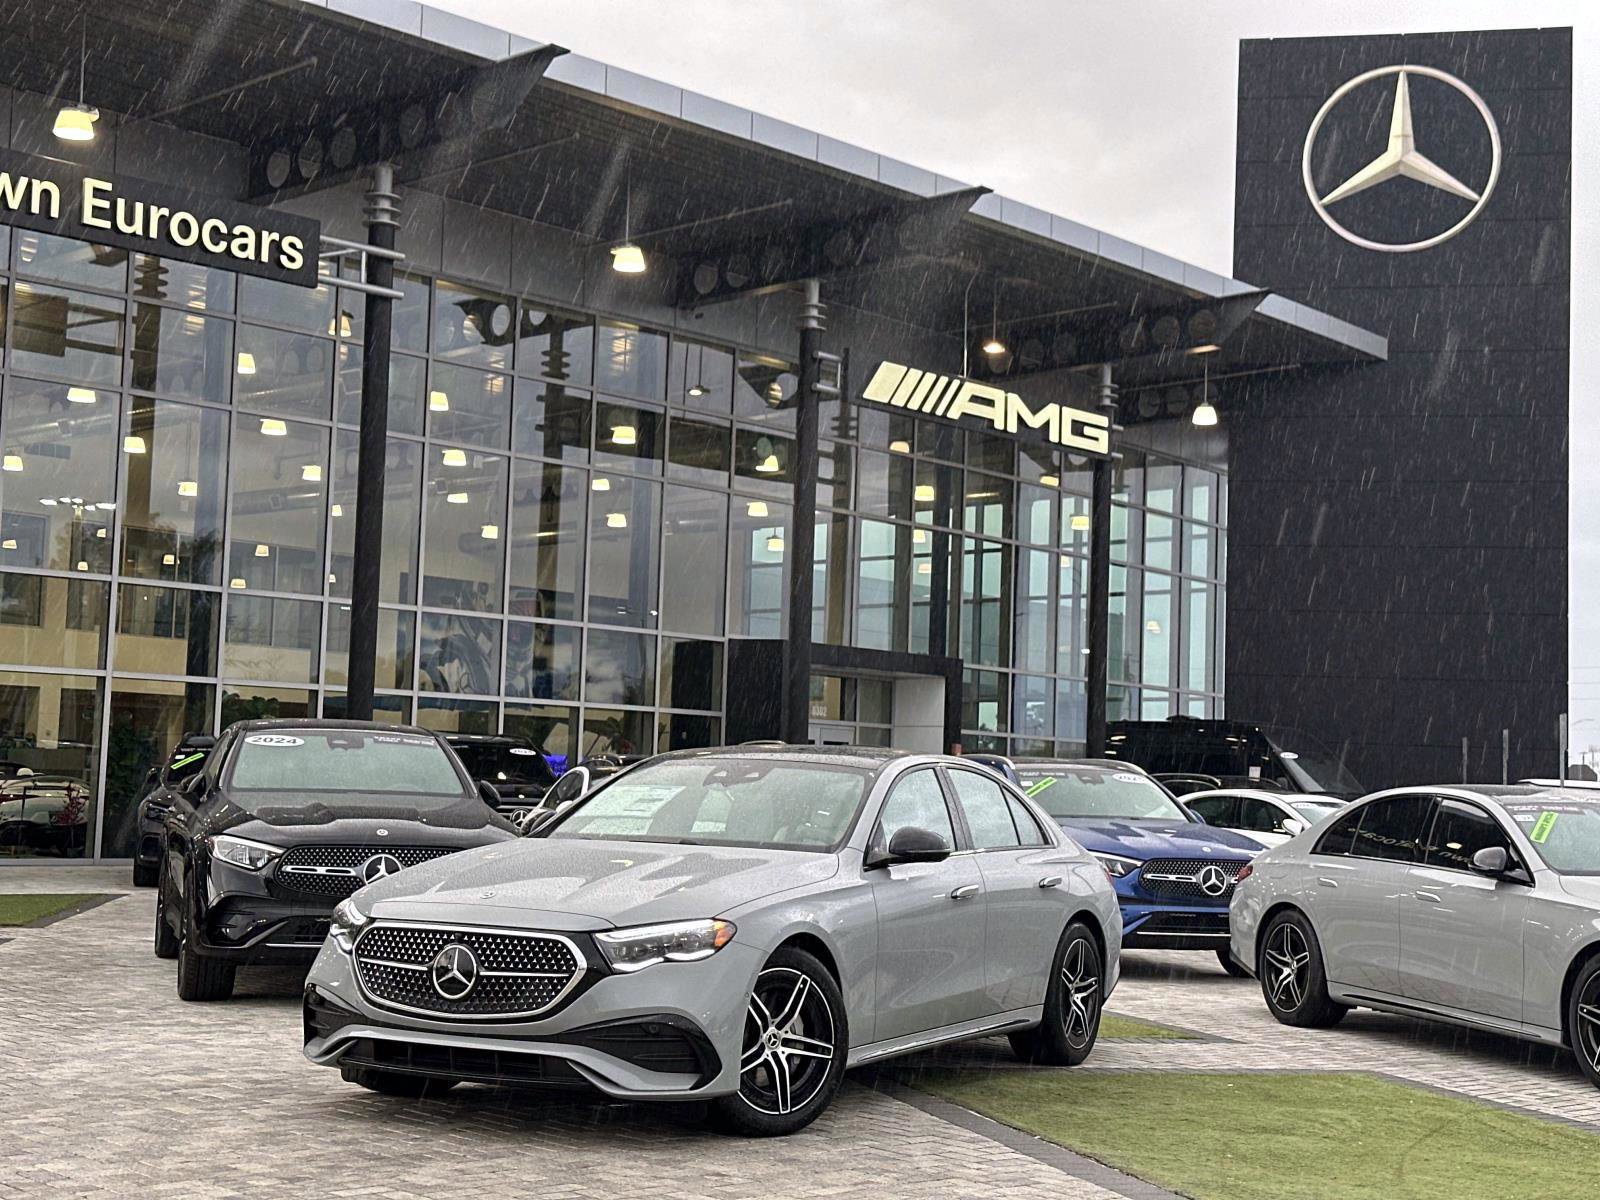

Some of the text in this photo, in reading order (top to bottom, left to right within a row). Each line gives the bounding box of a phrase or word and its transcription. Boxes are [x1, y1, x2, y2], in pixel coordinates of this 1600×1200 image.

[82, 177, 304, 270] Eurocars
[946, 381, 1109, 455] AMG
[251, 736, 298, 745] 2024
